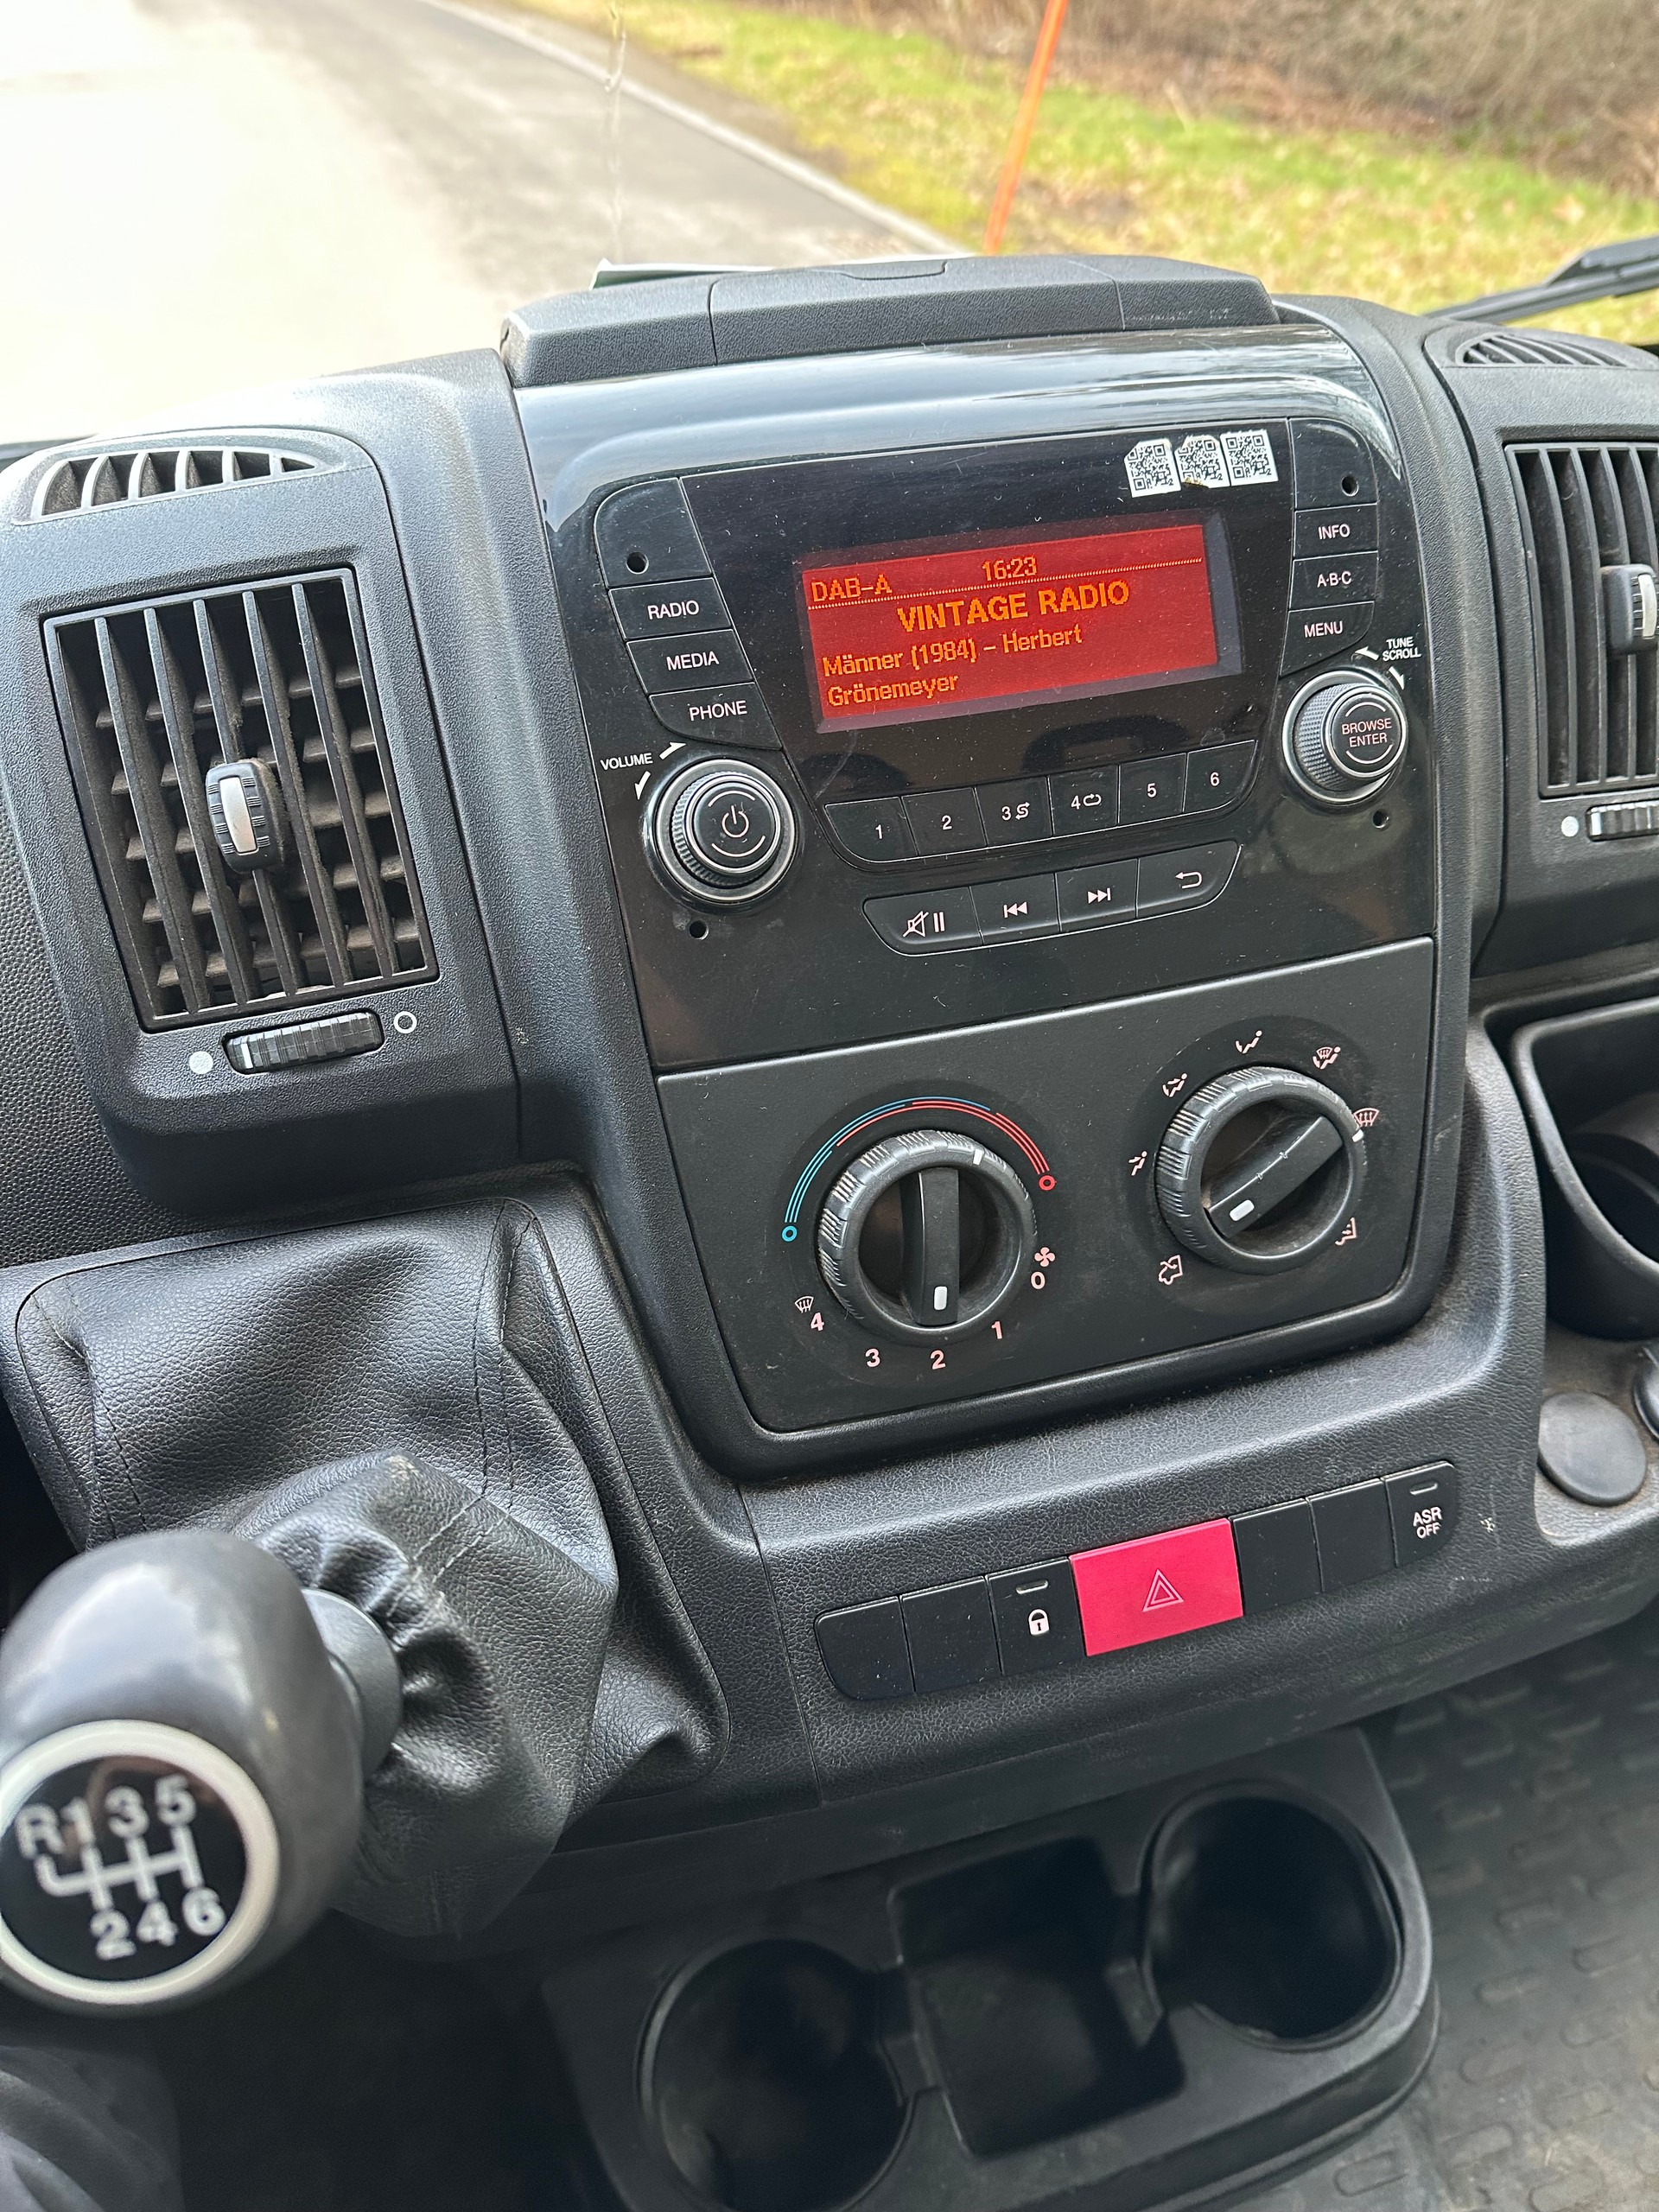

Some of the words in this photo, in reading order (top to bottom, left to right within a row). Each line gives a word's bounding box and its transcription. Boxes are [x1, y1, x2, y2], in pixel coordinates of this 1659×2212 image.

[1318, 523, 1351, 540] INFO
[982, 555, 1038, 582] 16:23
[811, 574, 892, 602] DAB-A
[647, 600, 700, 620] RADIO
[898, 594, 1028, 632] VINTAGE
[1039, 579, 1130, 615] RADIO
[1304, 620, 1344, 639] MENU
[822, 649, 904, 677] Männer
[912, 639, 977, 671] (1984)
[1002, 624, 1083, 655] Herbert
[1385, 635, 1414, 650] TUNE
[665, 651, 720, 671] MEDIA
[1382, 645, 1421, 662] SCROLL
[828, 672, 958, 708] Grönemeyer
[689, 700, 748, 721] PHONE
[1341, 717, 1392, 736] BROWSE
[1348, 732, 1388, 748] ENTER
[600, 752, 653, 771] VOLUME
[1210, 772, 1220, 787] 6
[1147, 782, 1157, 798] 5
[1071, 795, 1081, 810] 4
[941, 815, 952, 830] 2
[1001, 805, 1012, 821] 3
[875, 824, 883, 840] 1
[810, 1312, 825, 1332] 4
[991, 1320, 1003, 1340] 1
[865, 1348, 880, 1368] 3
[930, 1350, 946, 1370] 2
[1413, 1506, 1442, 1527] ASR
[1416, 1522, 1441, 1539] OFF
[15, 1803, 65, 1858] R
[60, 1796, 95, 1844] 1
[105, 1785, 149, 1838] 3
[155, 1774, 197, 1825] 5
[90, 1910, 137, 1961] 2
[137, 1901, 179, 1947] 4
[181, 1886, 226, 1936] 6
